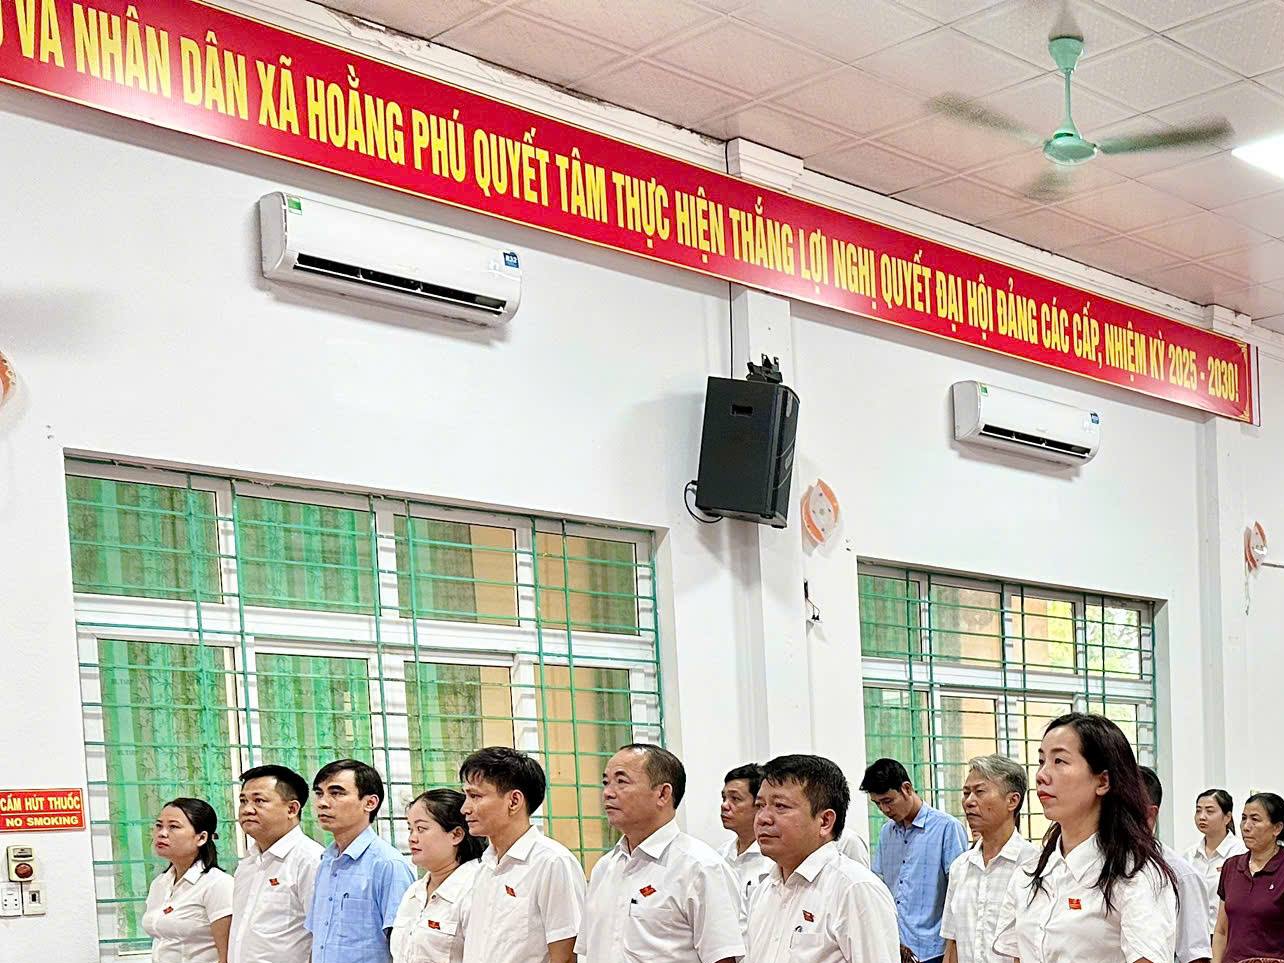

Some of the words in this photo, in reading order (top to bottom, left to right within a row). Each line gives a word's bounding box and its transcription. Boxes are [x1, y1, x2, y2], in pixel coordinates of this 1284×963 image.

[73, 2, 172, 98] NHÂN
[180, 30, 249, 120] DÂN
[256, 55, 300, 135] XÃ
[305, 64, 405, 166] HOẰNG
[411, 109, 466, 183] PHÚ
[473, 127, 550, 206] QUYẾT
[555, 146, 608, 224] TÂM
[612, 171, 670, 248] THỰC
[675, 186, 725, 263] HIỆN
[729, 196, 794, 276] THẮNG
[799, 227, 829, 294] LỢI
[833, 239, 877, 309] NGHỊ
[880, 249, 932, 315] QUYẾT
[936, 271, 963, 332] ĐẠI
[967, 273, 993, 340] HỘI
[996, 276, 1038, 345] ĐẢNG
[1041, 297, 1070, 354] CÁC
[1072, 301, 1103, 369] CẤP,
[1104, 320, 1148, 382] NHIỆM
[1149, 330, 1166, 381] KỲ
[1168, 344, 1198, 391] 2025
[1207, 355, 1240, 402] 2030!
[25, 794, 45, 811] HÚT
[47, 792, 80, 810] THUỐC
[6, 817, 23, 827] NO
[26, 816, 79, 827] SMOKING
